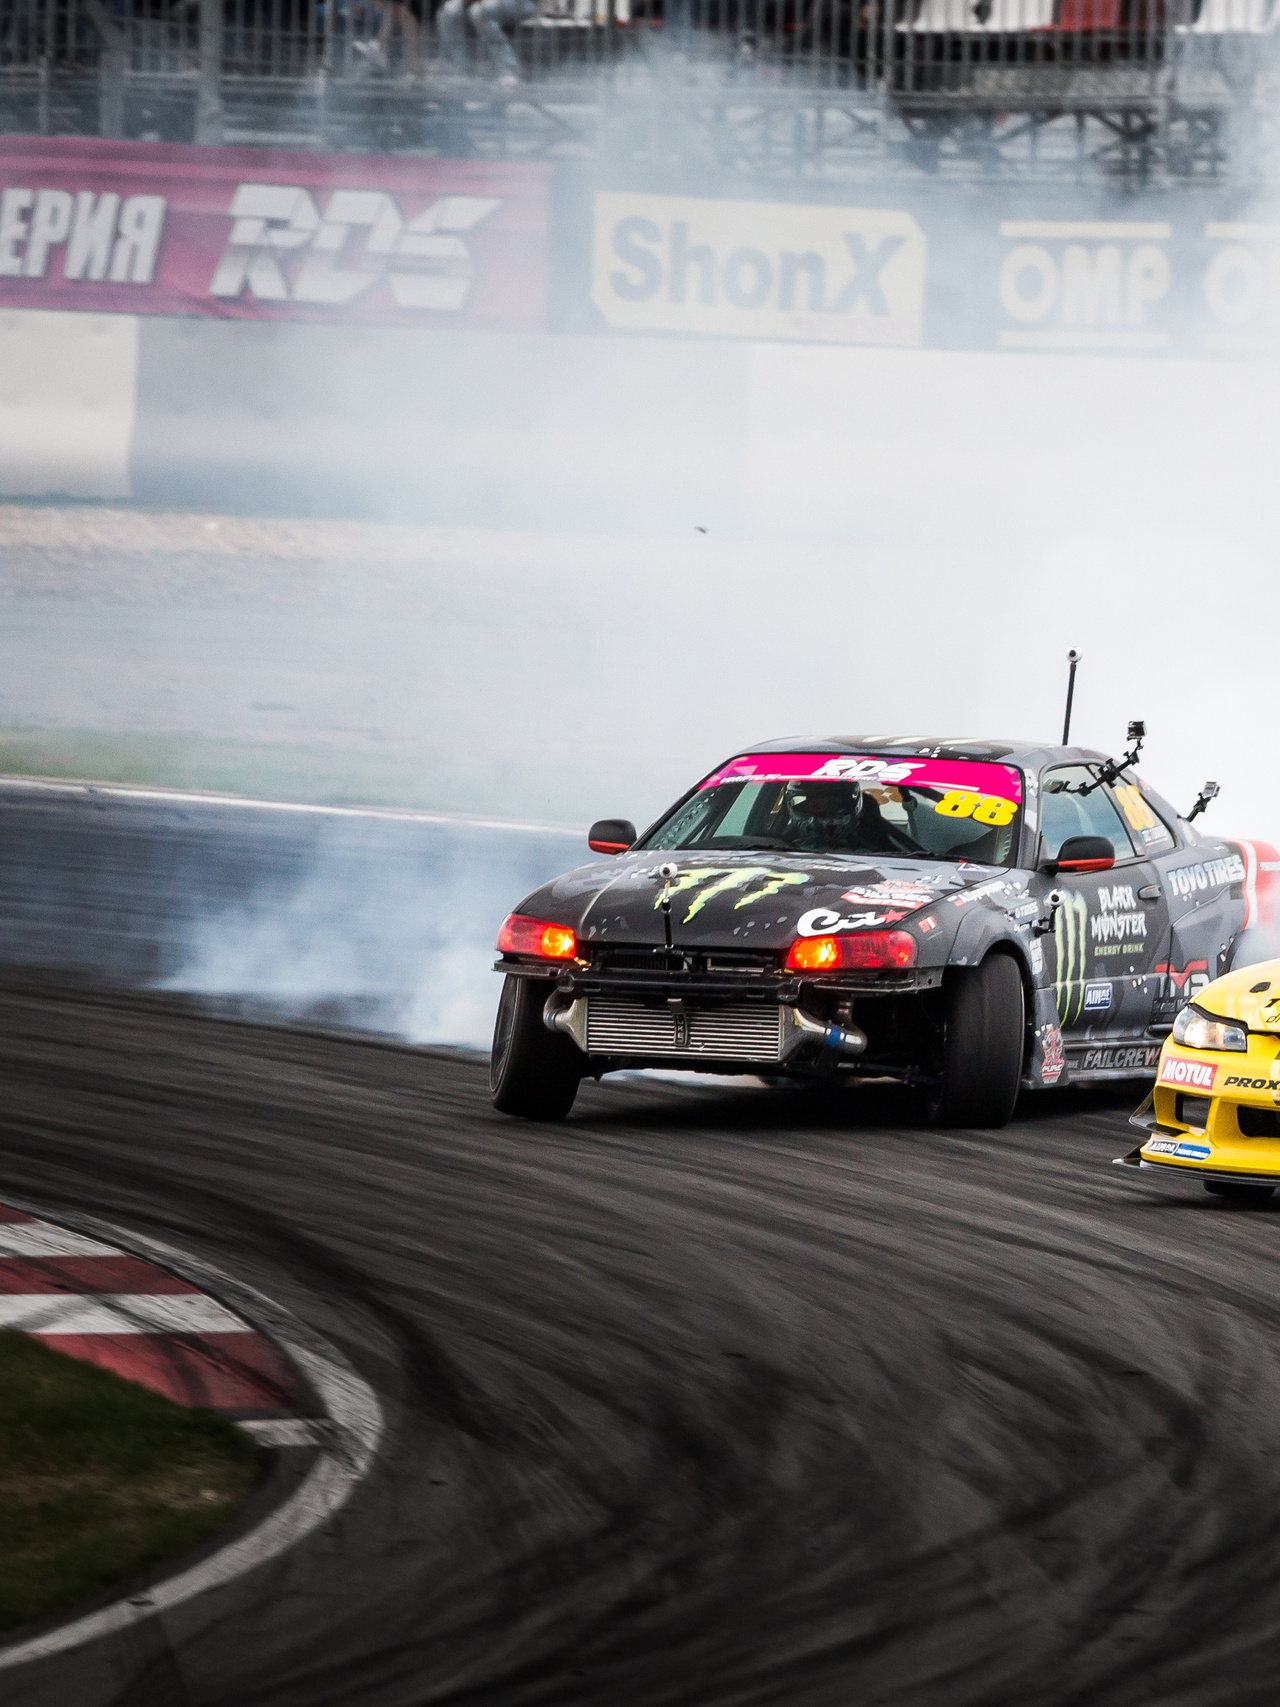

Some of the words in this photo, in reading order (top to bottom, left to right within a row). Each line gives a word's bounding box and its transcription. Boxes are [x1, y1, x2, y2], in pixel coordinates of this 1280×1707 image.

[209, 183, 505, 310] RDS
[608, 215, 908, 318] ShonX
[1000, 245, 1171, 325] OMP
[811, 758, 926, 779] RDS
[935, 791, 1018, 826] 88
[1115, 785, 1156, 832] 88
[1167, 863, 1204, 896] TOYO
[1202, 855, 1246, 886] TIRES
[1098, 884, 1136, 912] BLACK
[1094, 945, 1121, 957] ENERGY
[1123, 943, 1145, 954] DRINK
[1162, 1059, 1213, 1086] MOTUL
